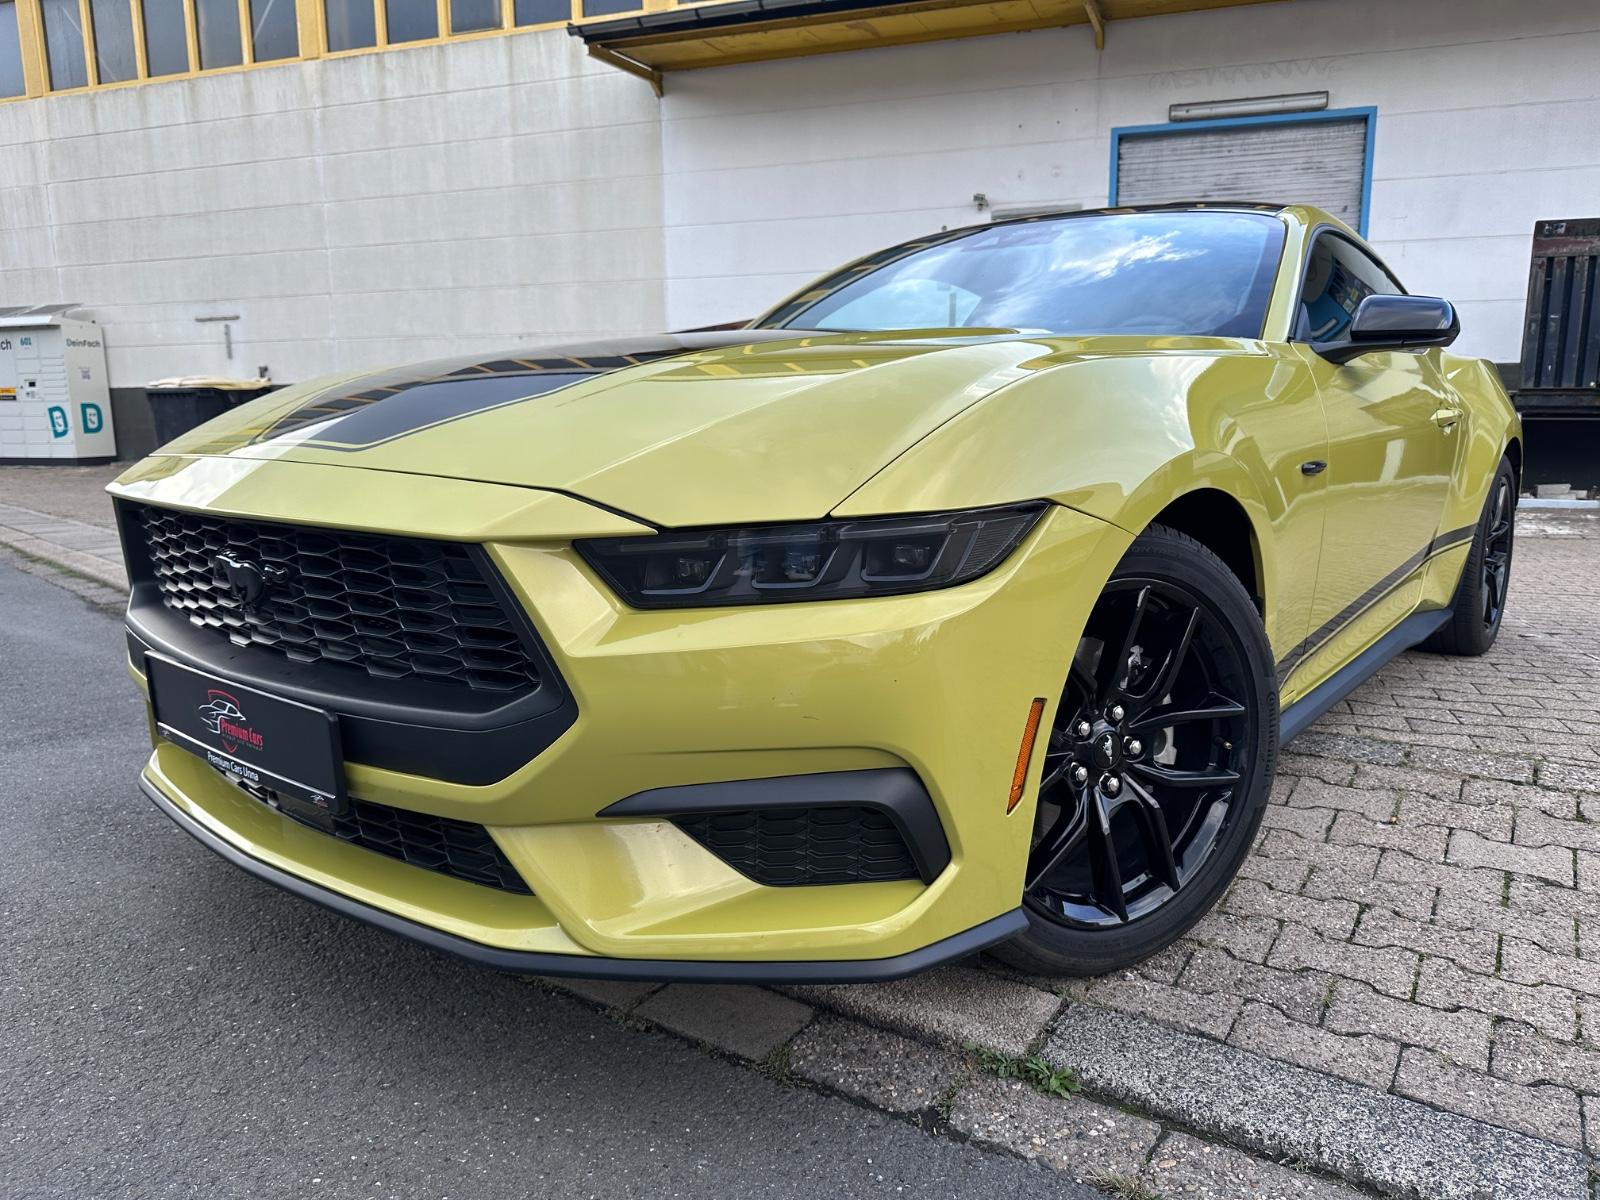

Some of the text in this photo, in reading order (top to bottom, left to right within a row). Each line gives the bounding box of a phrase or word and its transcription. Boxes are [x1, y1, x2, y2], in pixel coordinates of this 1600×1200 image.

[66, 338, 101, 348] DeinFach
[221, 718, 249, 741] Premium
[249, 727, 263, 746] Cars
[207, 751, 259, 782] Premium Cars Unna
